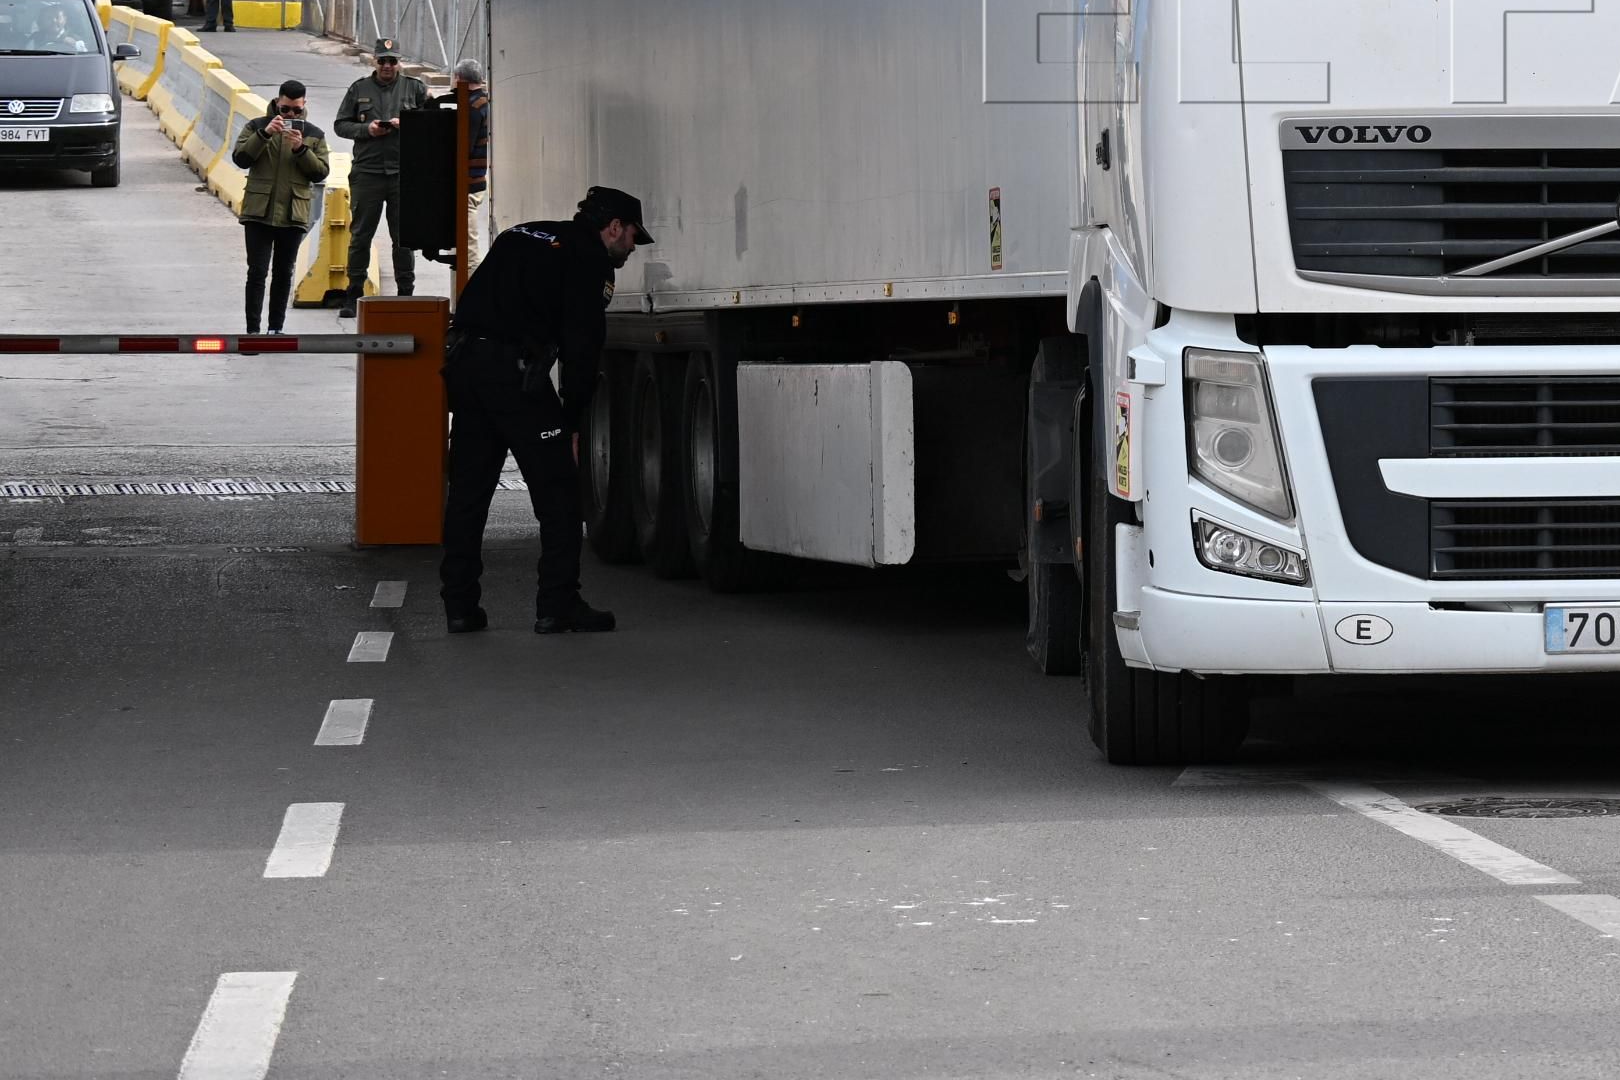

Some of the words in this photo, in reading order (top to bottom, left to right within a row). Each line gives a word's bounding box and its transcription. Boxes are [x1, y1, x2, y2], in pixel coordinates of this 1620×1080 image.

[26, 130, 47, 140] FVT
[1294, 125, 1432, 144] VOLVO
[508, 227, 557, 243] OLICIA
[540, 428, 562, 439] CNP
[1356, 619, 1372, 640] E
